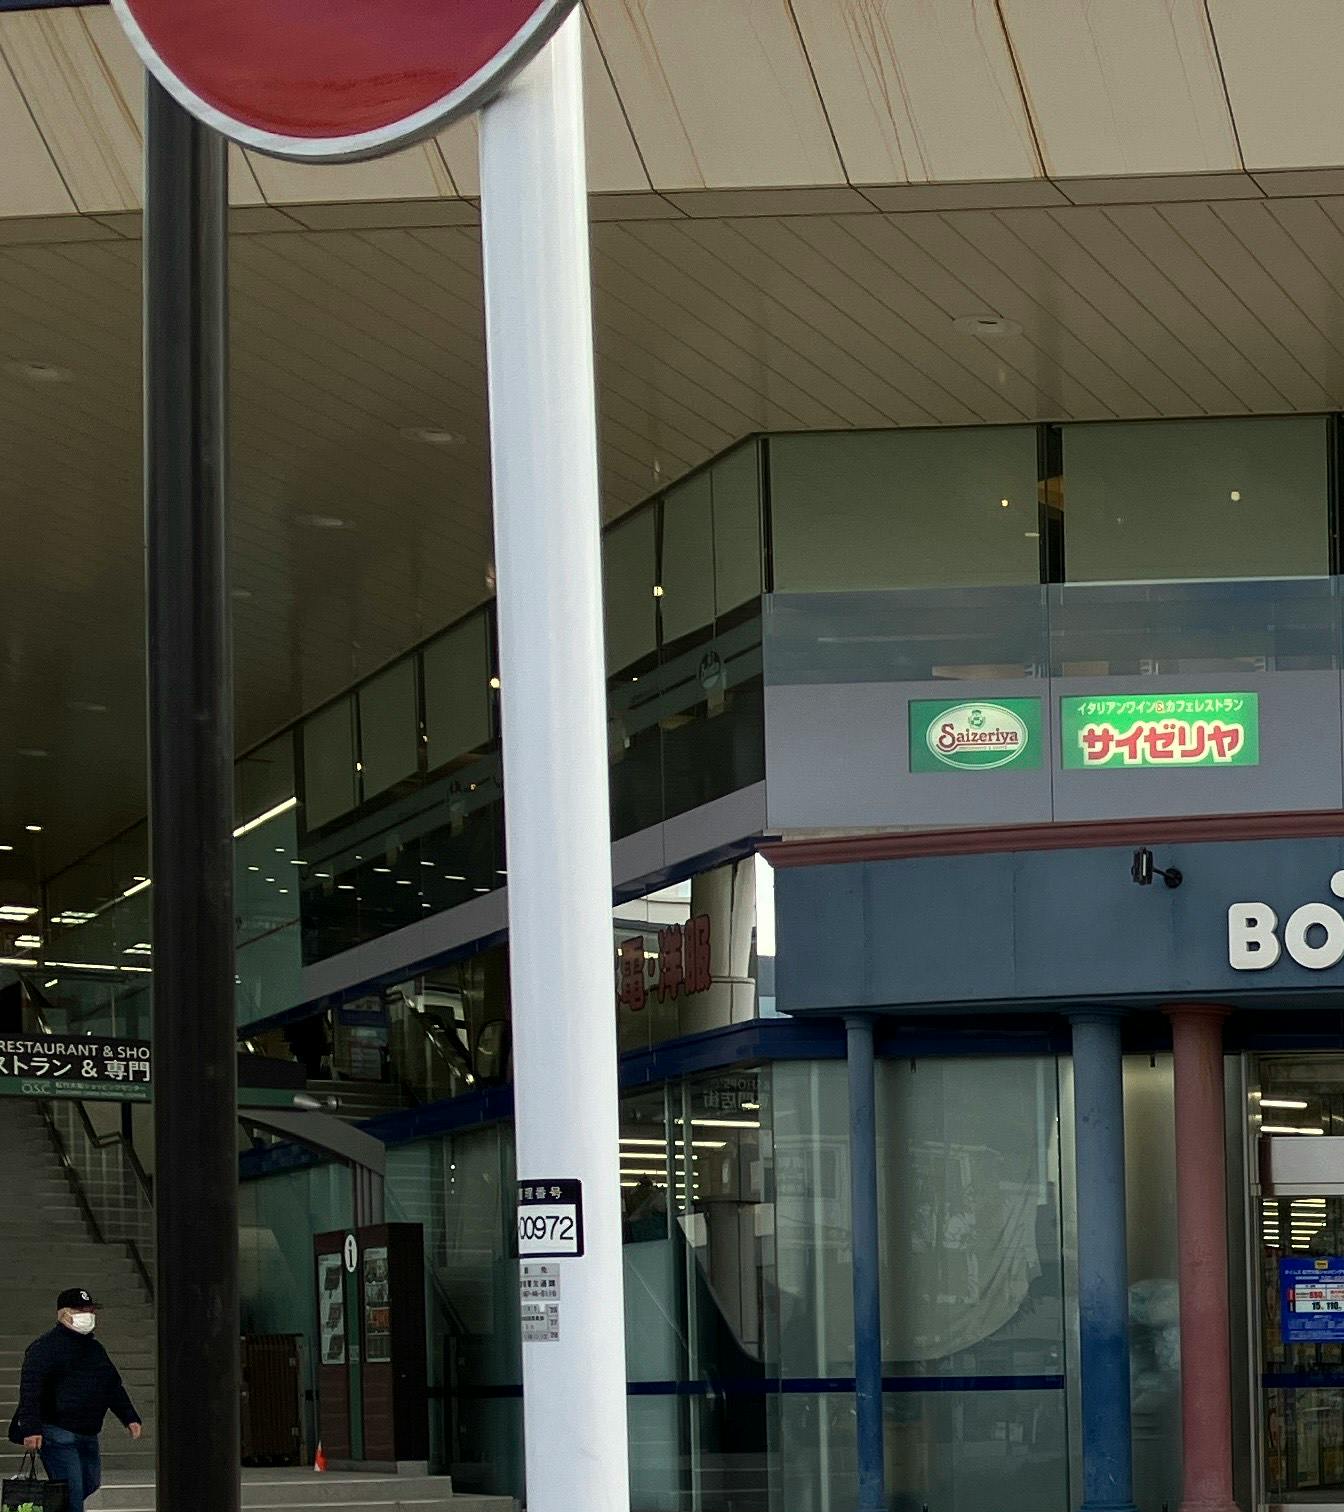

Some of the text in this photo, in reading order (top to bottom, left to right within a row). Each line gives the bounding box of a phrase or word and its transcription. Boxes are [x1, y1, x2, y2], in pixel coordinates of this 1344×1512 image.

[936, 723, 1019, 752] Saizeriya
[1083, 723, 1239, 760] サイゼリヤ
[616, 914, 712, 1012] 電・洋服
[0, 1040, 150, 1059] RESTAURANT & SHO
[104, 1060, 150, 1082] 専門
